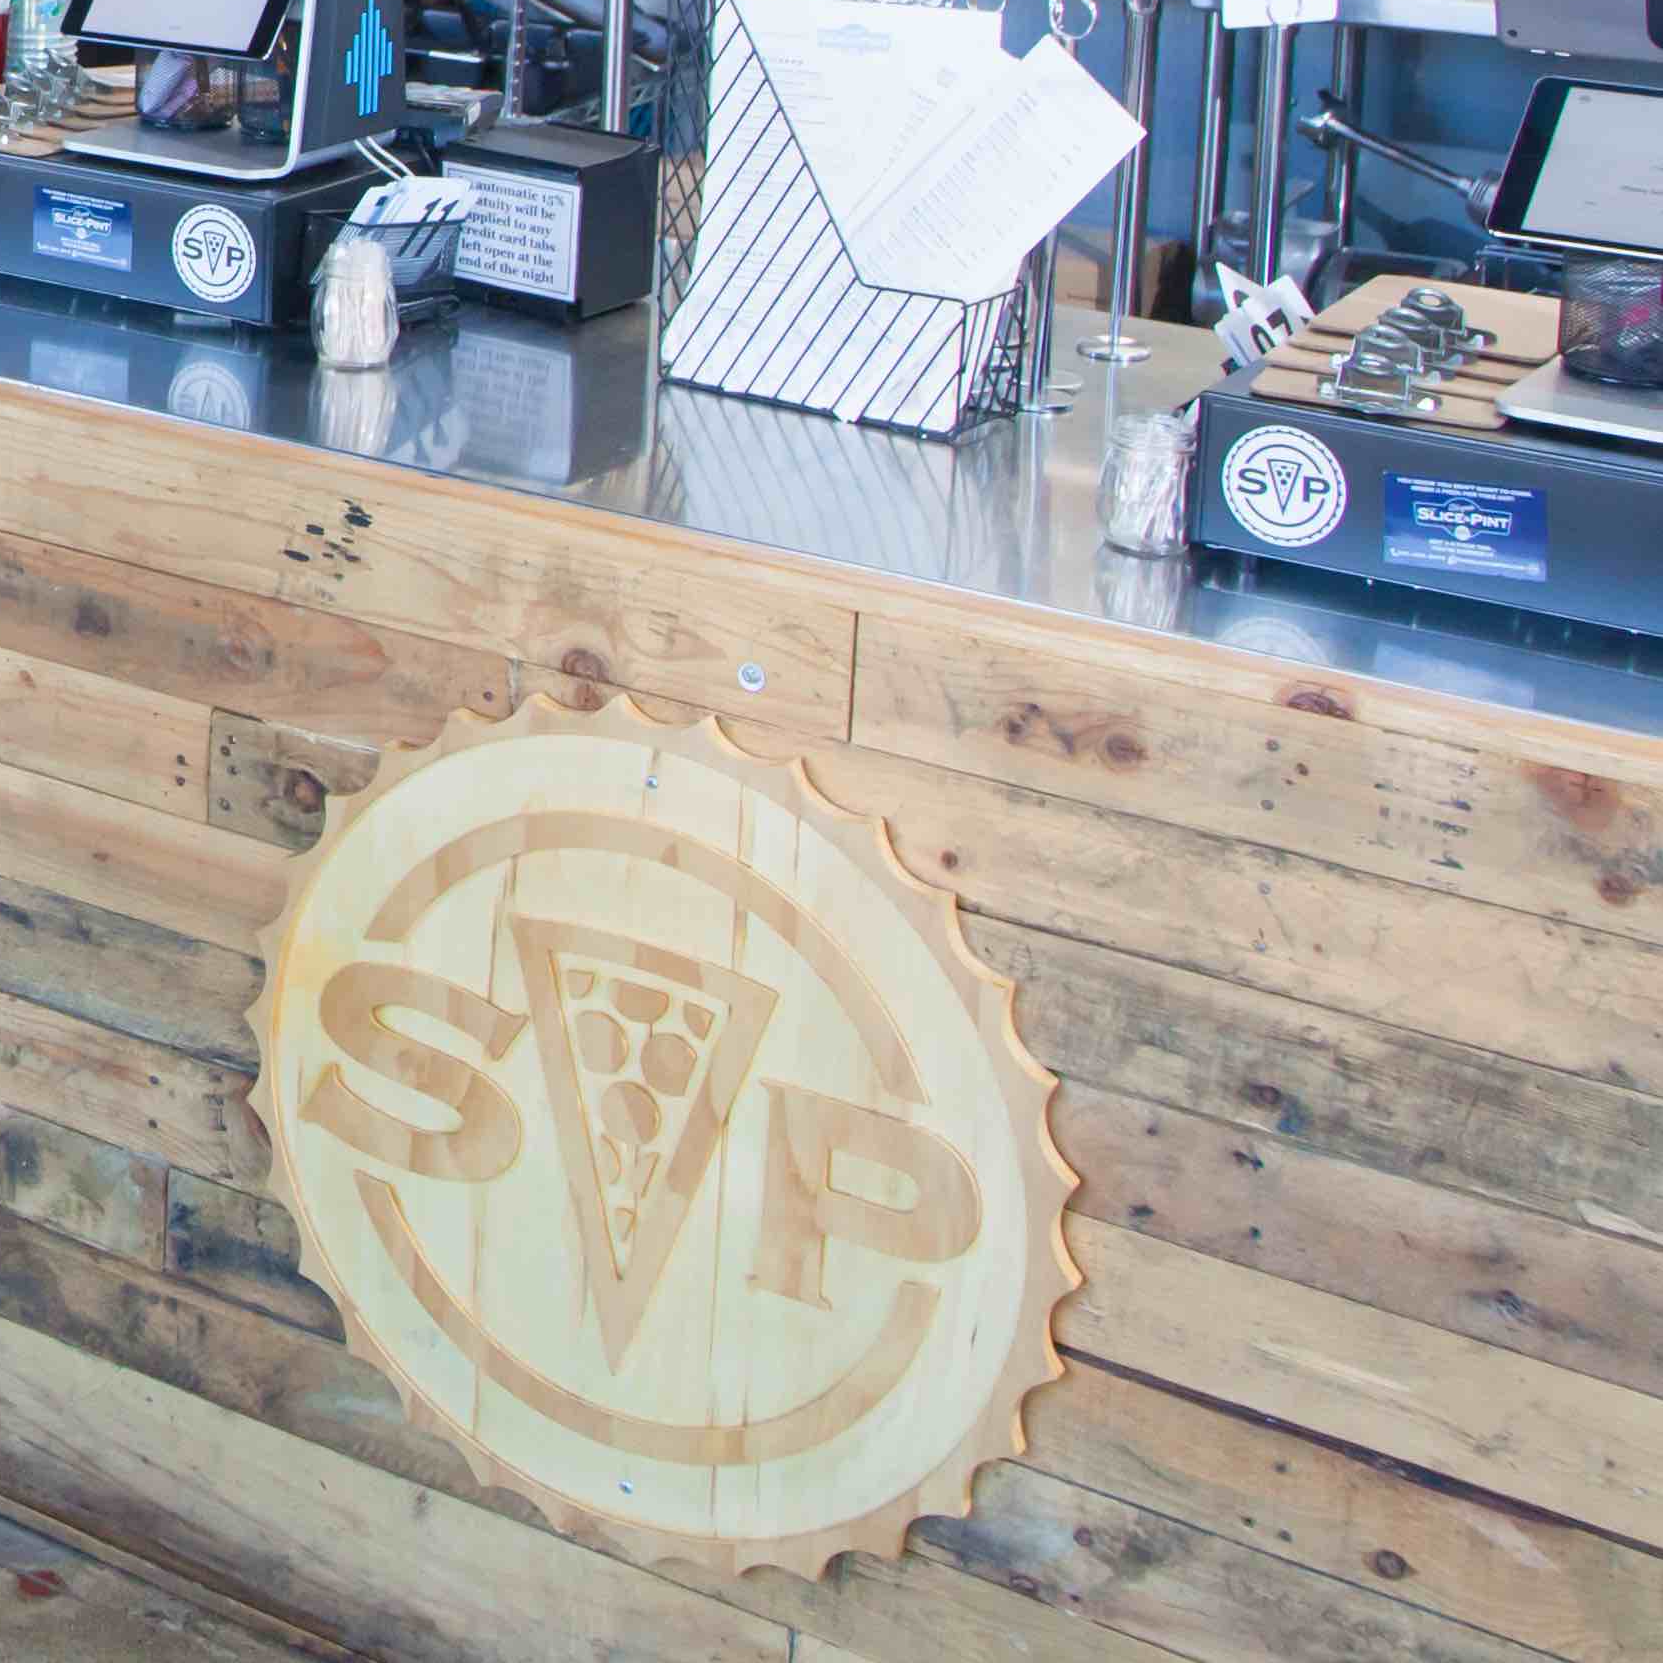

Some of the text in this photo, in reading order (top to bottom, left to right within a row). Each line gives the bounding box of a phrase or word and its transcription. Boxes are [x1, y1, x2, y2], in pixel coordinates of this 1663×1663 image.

[466, 210, 553, 236] applied to any
[514, 201, 539, 216] will
[540, 205, 556, 220] be
[461, 238, 553, 268] left open at the
[499, 230, 527, 247] card
[529, 238, 556, 253] tabs
[458, 255, 554, 285] end of the night
